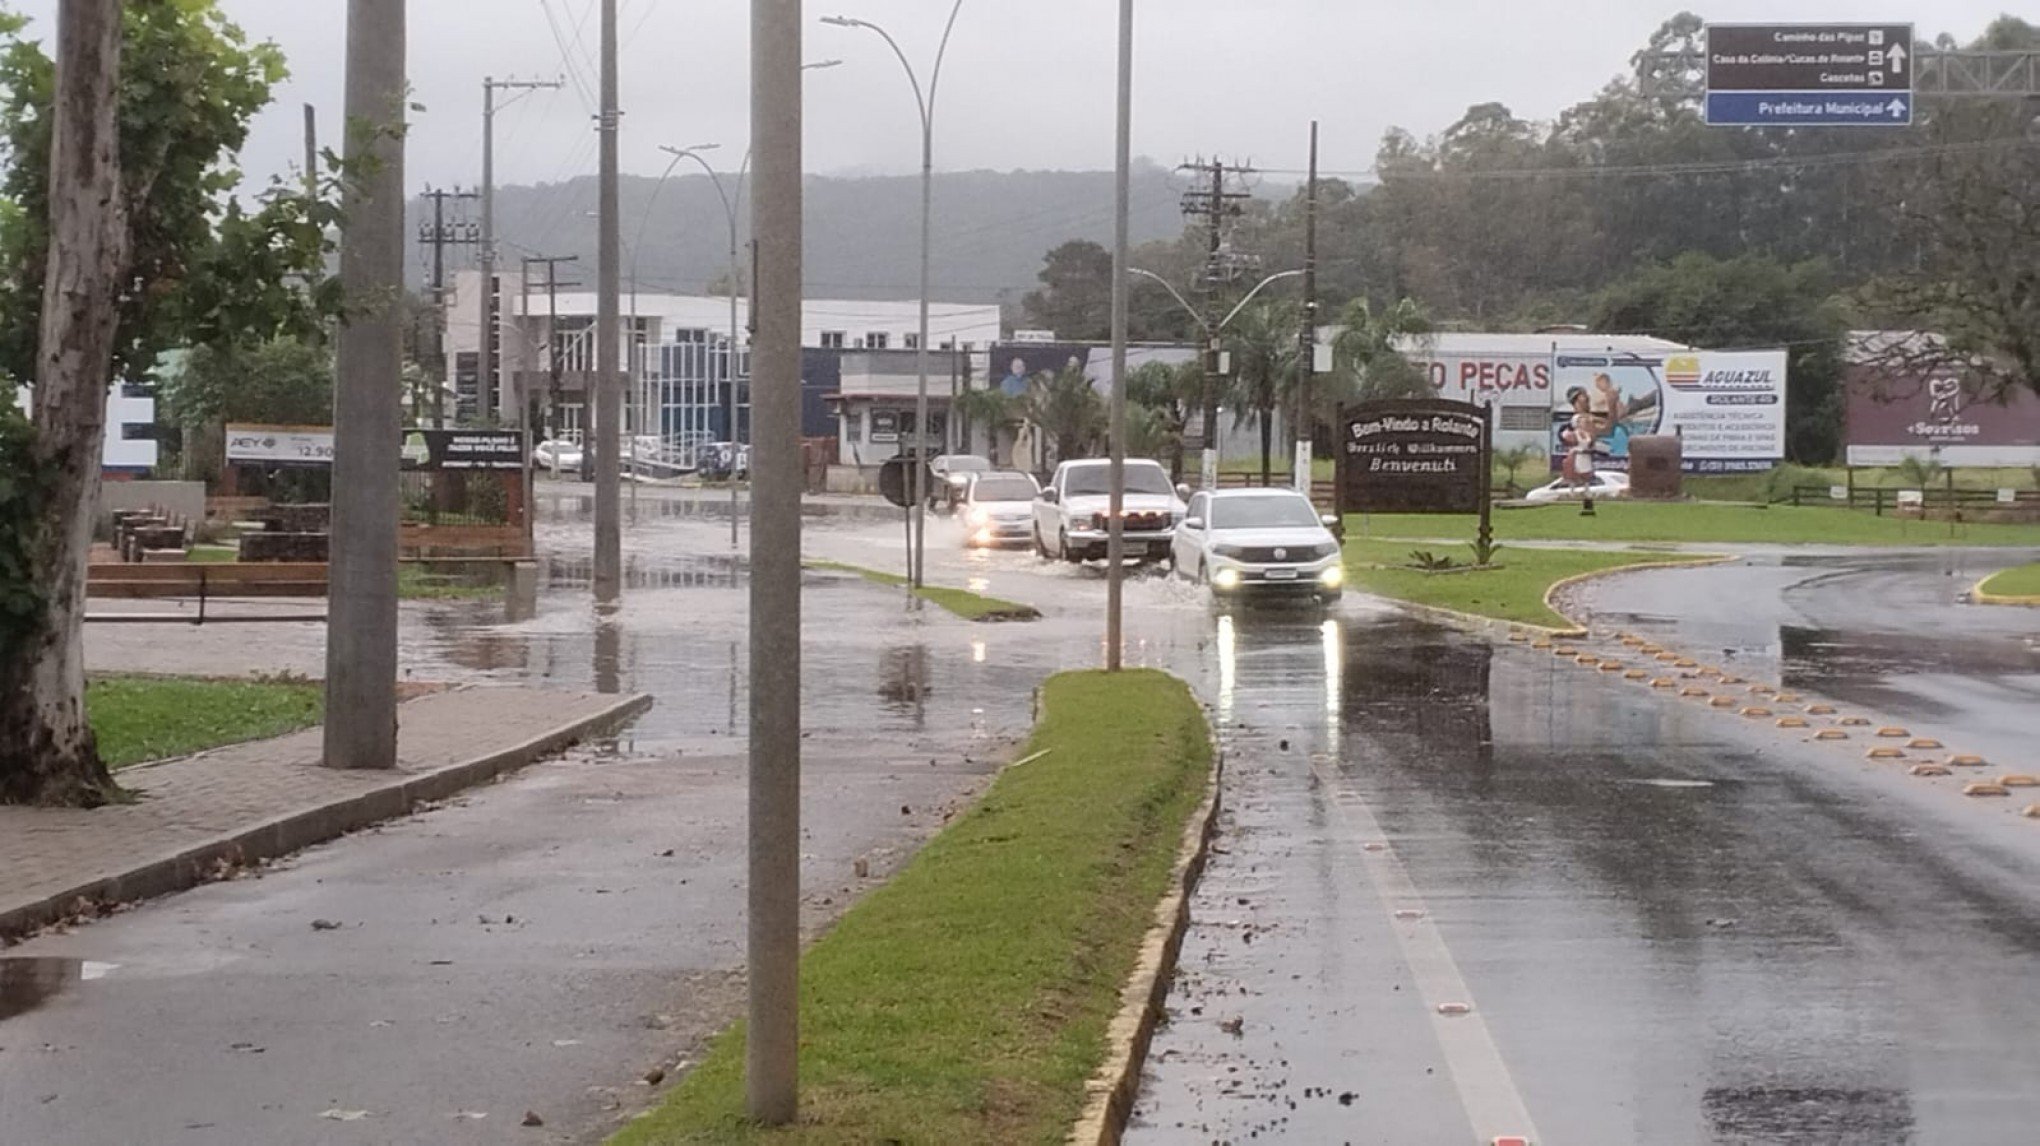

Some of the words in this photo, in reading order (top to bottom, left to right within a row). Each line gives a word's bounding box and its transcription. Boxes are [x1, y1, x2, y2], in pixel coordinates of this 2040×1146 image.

[1758, 102, 1823, 114] Prefeitura
[1826, 102, 1884, 117] Municipal
[1702, 370, 1773, 384] AGUAZUL
[1421, 420, 1429, 431] a
[1431, 417, 1479, 438] Rolante
[1369, 458, 1457, 472] Benvenuti
